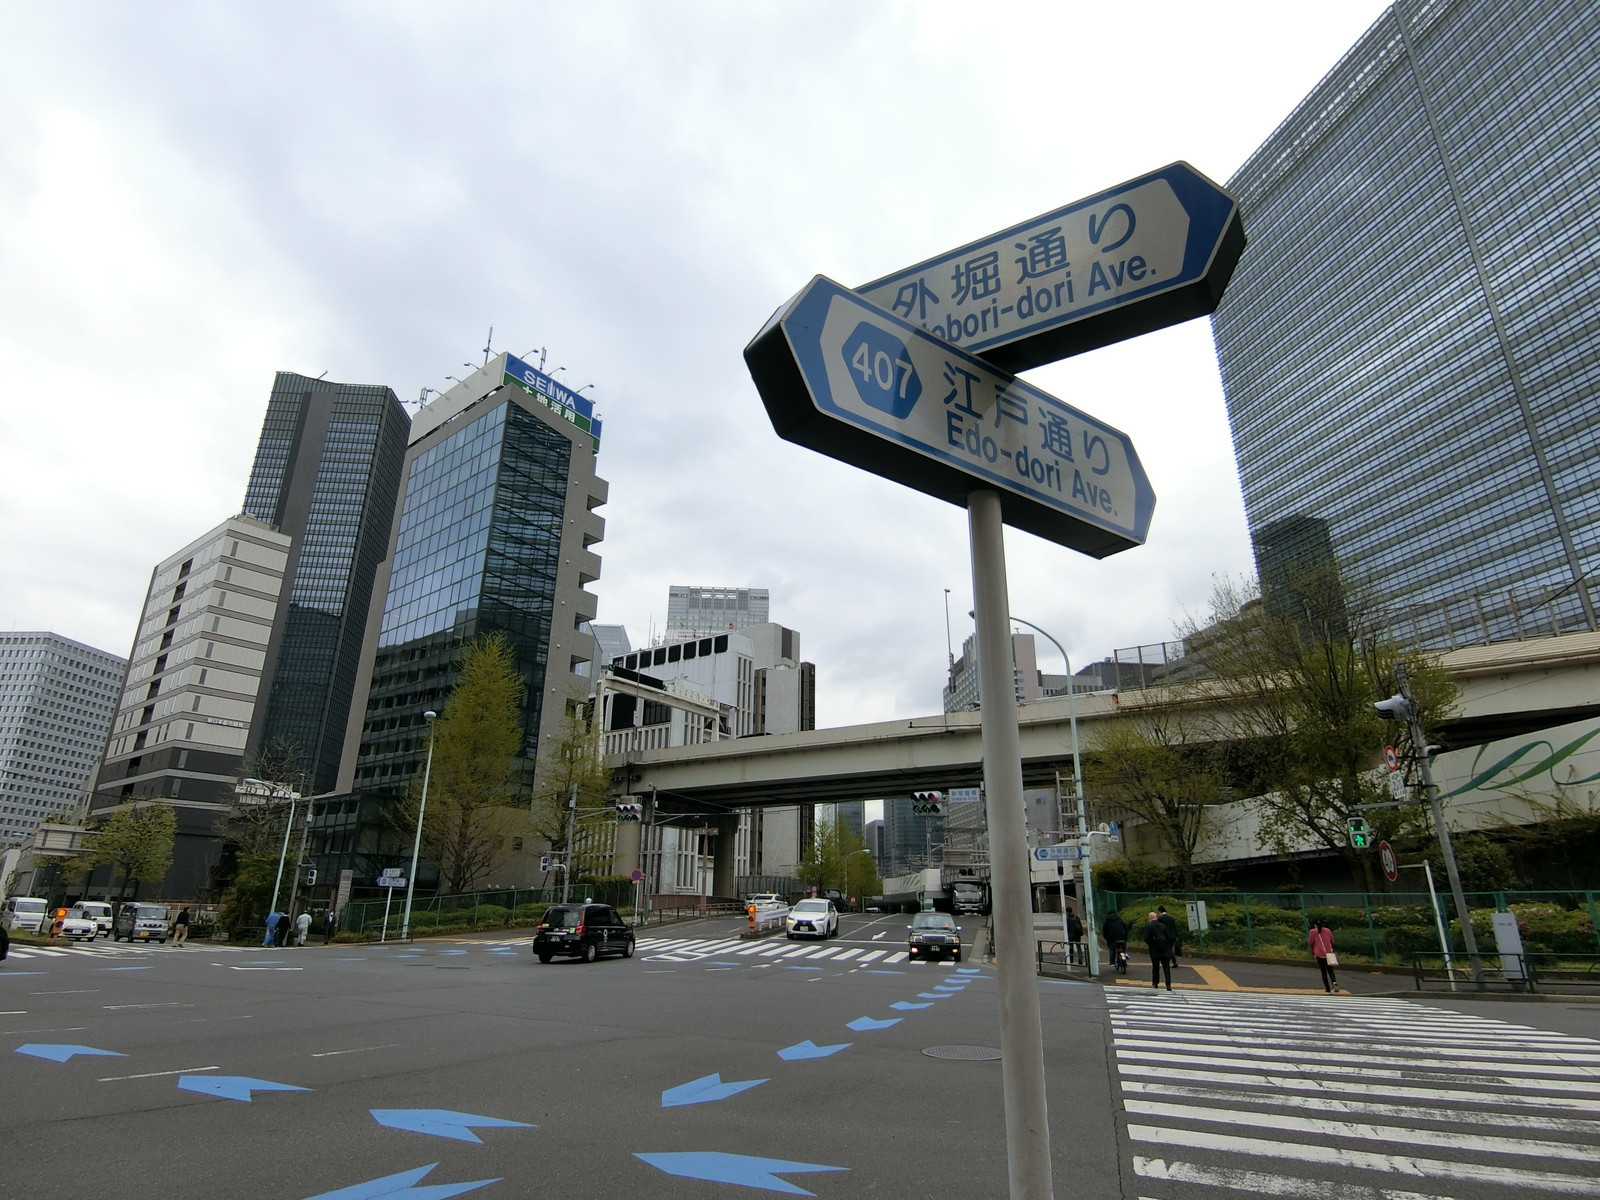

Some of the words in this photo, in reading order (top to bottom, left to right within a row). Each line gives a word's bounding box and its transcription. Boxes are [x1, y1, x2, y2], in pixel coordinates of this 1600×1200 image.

[892, 203, 1136, 319] 外堀通り
[922, 271, 1075, 342] obori-dori
[1088, 255, 1156, 296] Ave.
[523, 370, 576, 409] SEIWA
[852, 342, 913, 399] 407
[943, 361, 1110, 475] 江戸通り
[946, 410, 1062, 492] Edo-dori
[1072, 469, 1118, 516] Ave.
